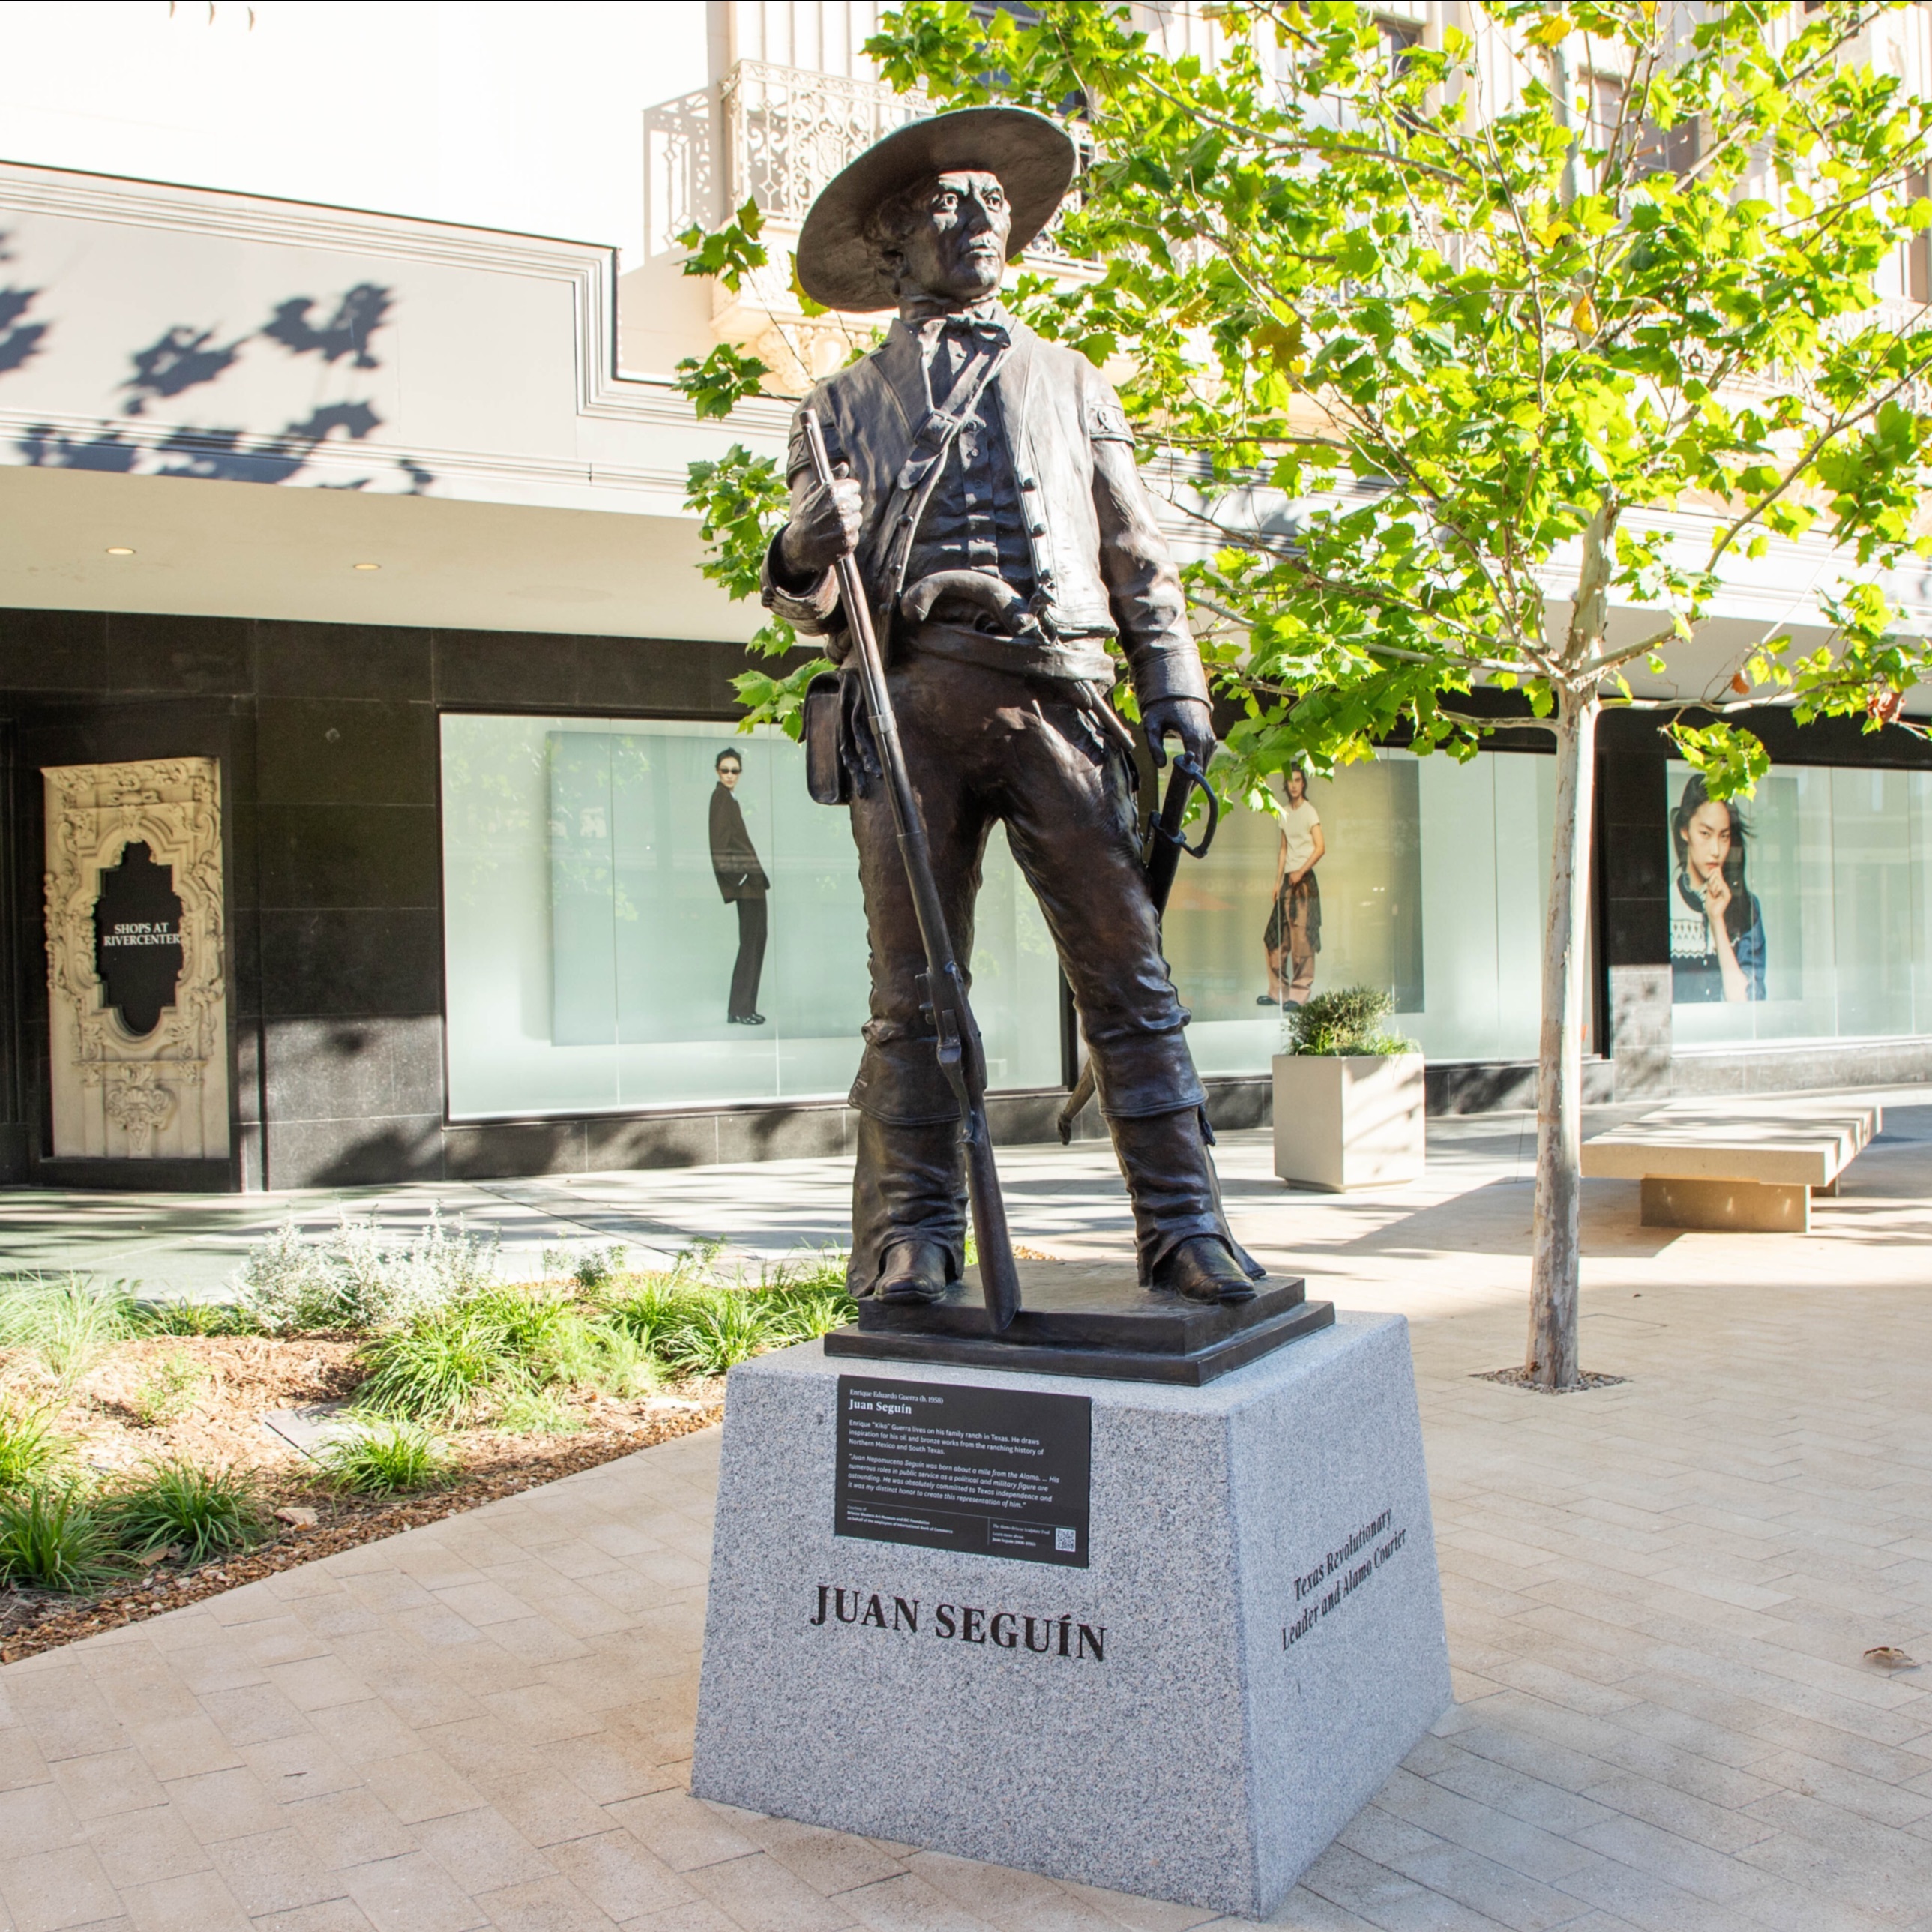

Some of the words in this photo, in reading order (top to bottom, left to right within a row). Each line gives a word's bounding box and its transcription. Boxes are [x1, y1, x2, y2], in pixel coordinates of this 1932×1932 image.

[114, 923, 151, 935] SHOPS
[153, 922, 169, 933] AT
[103, 933, 181, 947] RIVERCENTER
[850, 1389, 872, 1397] Enrique
[849, 1399, 873, 1410] Juan
[876, 1402, 912, 1414] Seguín
[946, 1430, 964, 1438] family
[987, 1445, 1013, 1454] ranching
[1014, 1446, 1036, 1455] history
[867, 1456, 903, 1465] Nepomuceno
[848, 1474, 880, 1483] astounding.
[905, 1480, 935, 1489] absolutely
[996, 1490, 1038, 1500] independence
[993, 1481, 1017, 1489] military
[1017, 1482, 1036, 1490] figure
[957, 1496, 1000, 1505] representation
[1293, 1563, 1325, 1601] Texas
[1325, 1508, 1392, 1577] Revolutionary
[1281, 1604, 1319, 1652] Leader
[1322, 1580, 1340, 1617] and
[1342, 1557, 1373, 1598] Alamo
[1374, 1528, 1407, 1568] Courier
[810, 1585, 920, 1634] JUAN
[935, 1604, 1107, 1662] SEGUÍN
